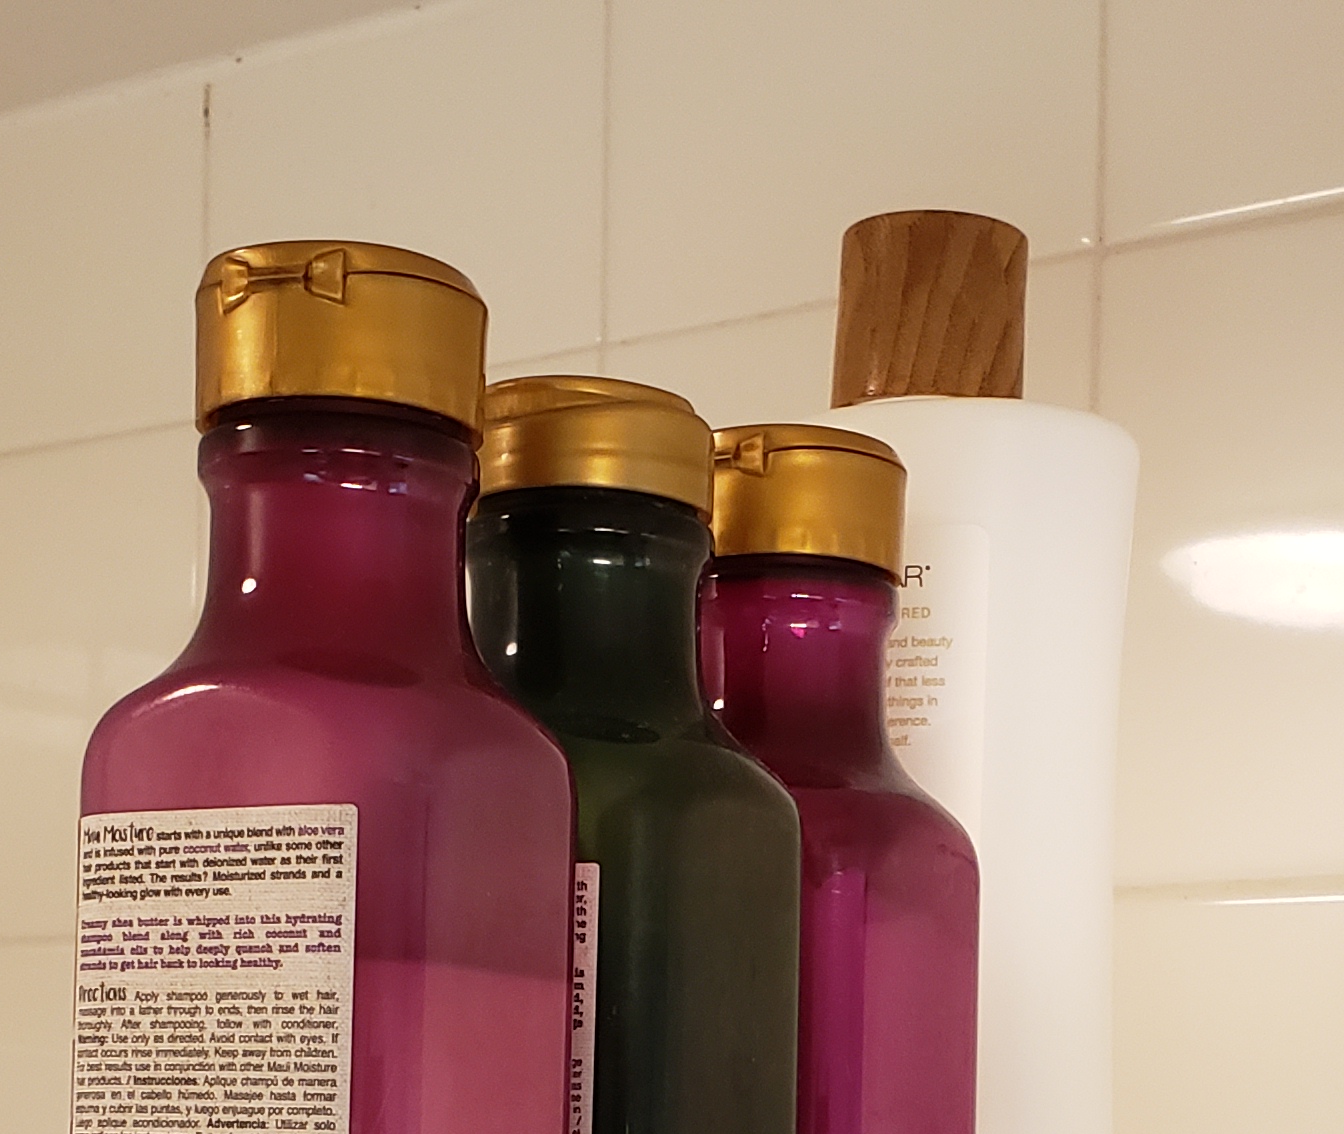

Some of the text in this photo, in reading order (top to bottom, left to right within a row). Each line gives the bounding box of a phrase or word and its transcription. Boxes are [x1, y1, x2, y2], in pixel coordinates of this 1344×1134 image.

[911, 634, 953, 649] beauty
[895, 655, 938, 667] crafted
[895, 676, 917, 687] that
[157, 831, 182, 840] starts
[184, 829, 203, 840] with
[205, 831, 211, 839] a
[213, 828, 245, 841] unique
[247, 826, 273, 837] blend
[275, 826, 294, 836] with
[298, 825, 318, 836] aloe
[321, 826, 344, 836] vera
[104, 840, 344, 857] infused with pure coconut unlike some other
[95, 861, 131, 874] products
[135, 860, 152, 869] that
[155, 860, 176, 869] start
[179, 858, 198, 868] with
[203, 856, 247, 867] deionized
[280, 857, 291, 865] as
[296, 854, 318, 864] their
[322, 854, 343, 864] first
[150, 868, 343, 883] The strands and a
[140, 886, 232, 900] glow with every use.
[173, 913, 343, 927] is whipped into this hydrating
[160, 928, 341, 942] along with rich coconut and
[153, 942, 341, 956] to help deeply and soften
[120, 957, 283, 972] get hair to looking healthy.
[215, 990, 309, 1003] generously to wet
[205, 1004, 340, 1015] to then rinse the hair
[253, 1019, 272, 1029] with
[131, 1032, 340, 1046] only Avoid contact with eyes. If
[241, 1047, 338, 1060] away from children.
[218, 1061, 237, 1071] with
[294, 1061, 337, 1073] Moisture
[282, 1076, 295, 1086] de
[270, 1090, 337, 1102] hasta formar
[268, 1107, 284, 1118] por
[314, 1120, 336, 1130] solo
